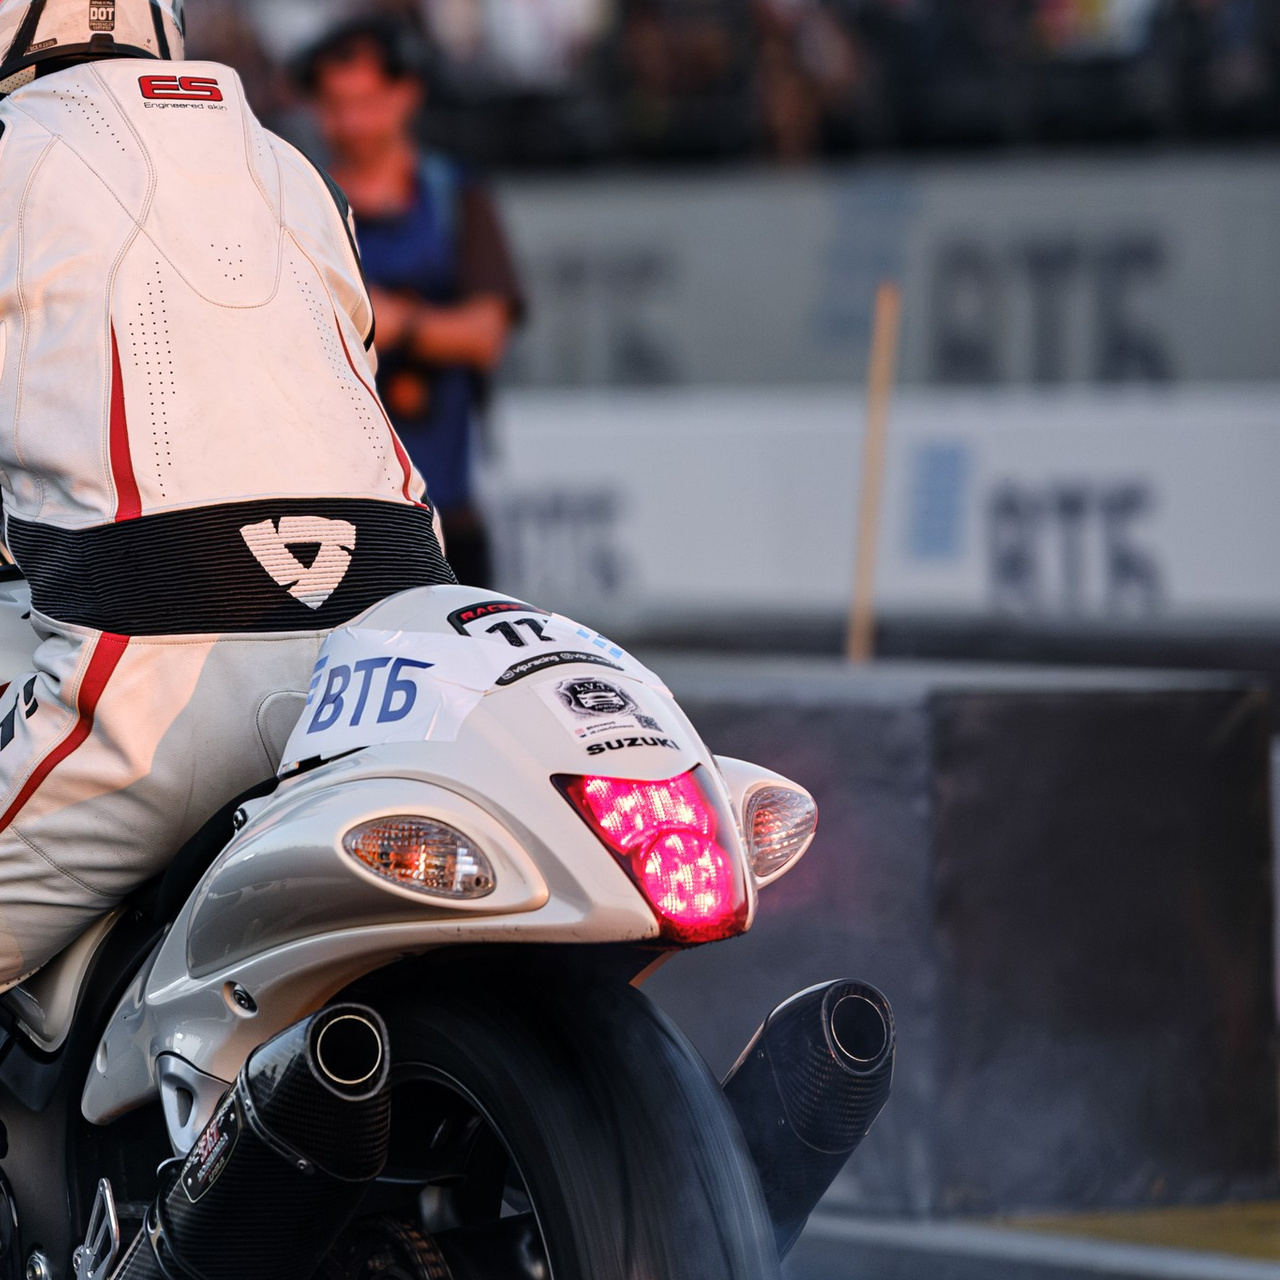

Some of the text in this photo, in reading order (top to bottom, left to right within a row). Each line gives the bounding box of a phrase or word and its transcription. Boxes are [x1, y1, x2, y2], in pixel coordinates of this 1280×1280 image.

[90, 7, 114, 21] DOT
[137, 75, 223, 102] ES
[143, 101, 204, 109] Engineered
[306, 656, 436, 735] ВТБ
[586, 737, 681, 756] SUZUKI
